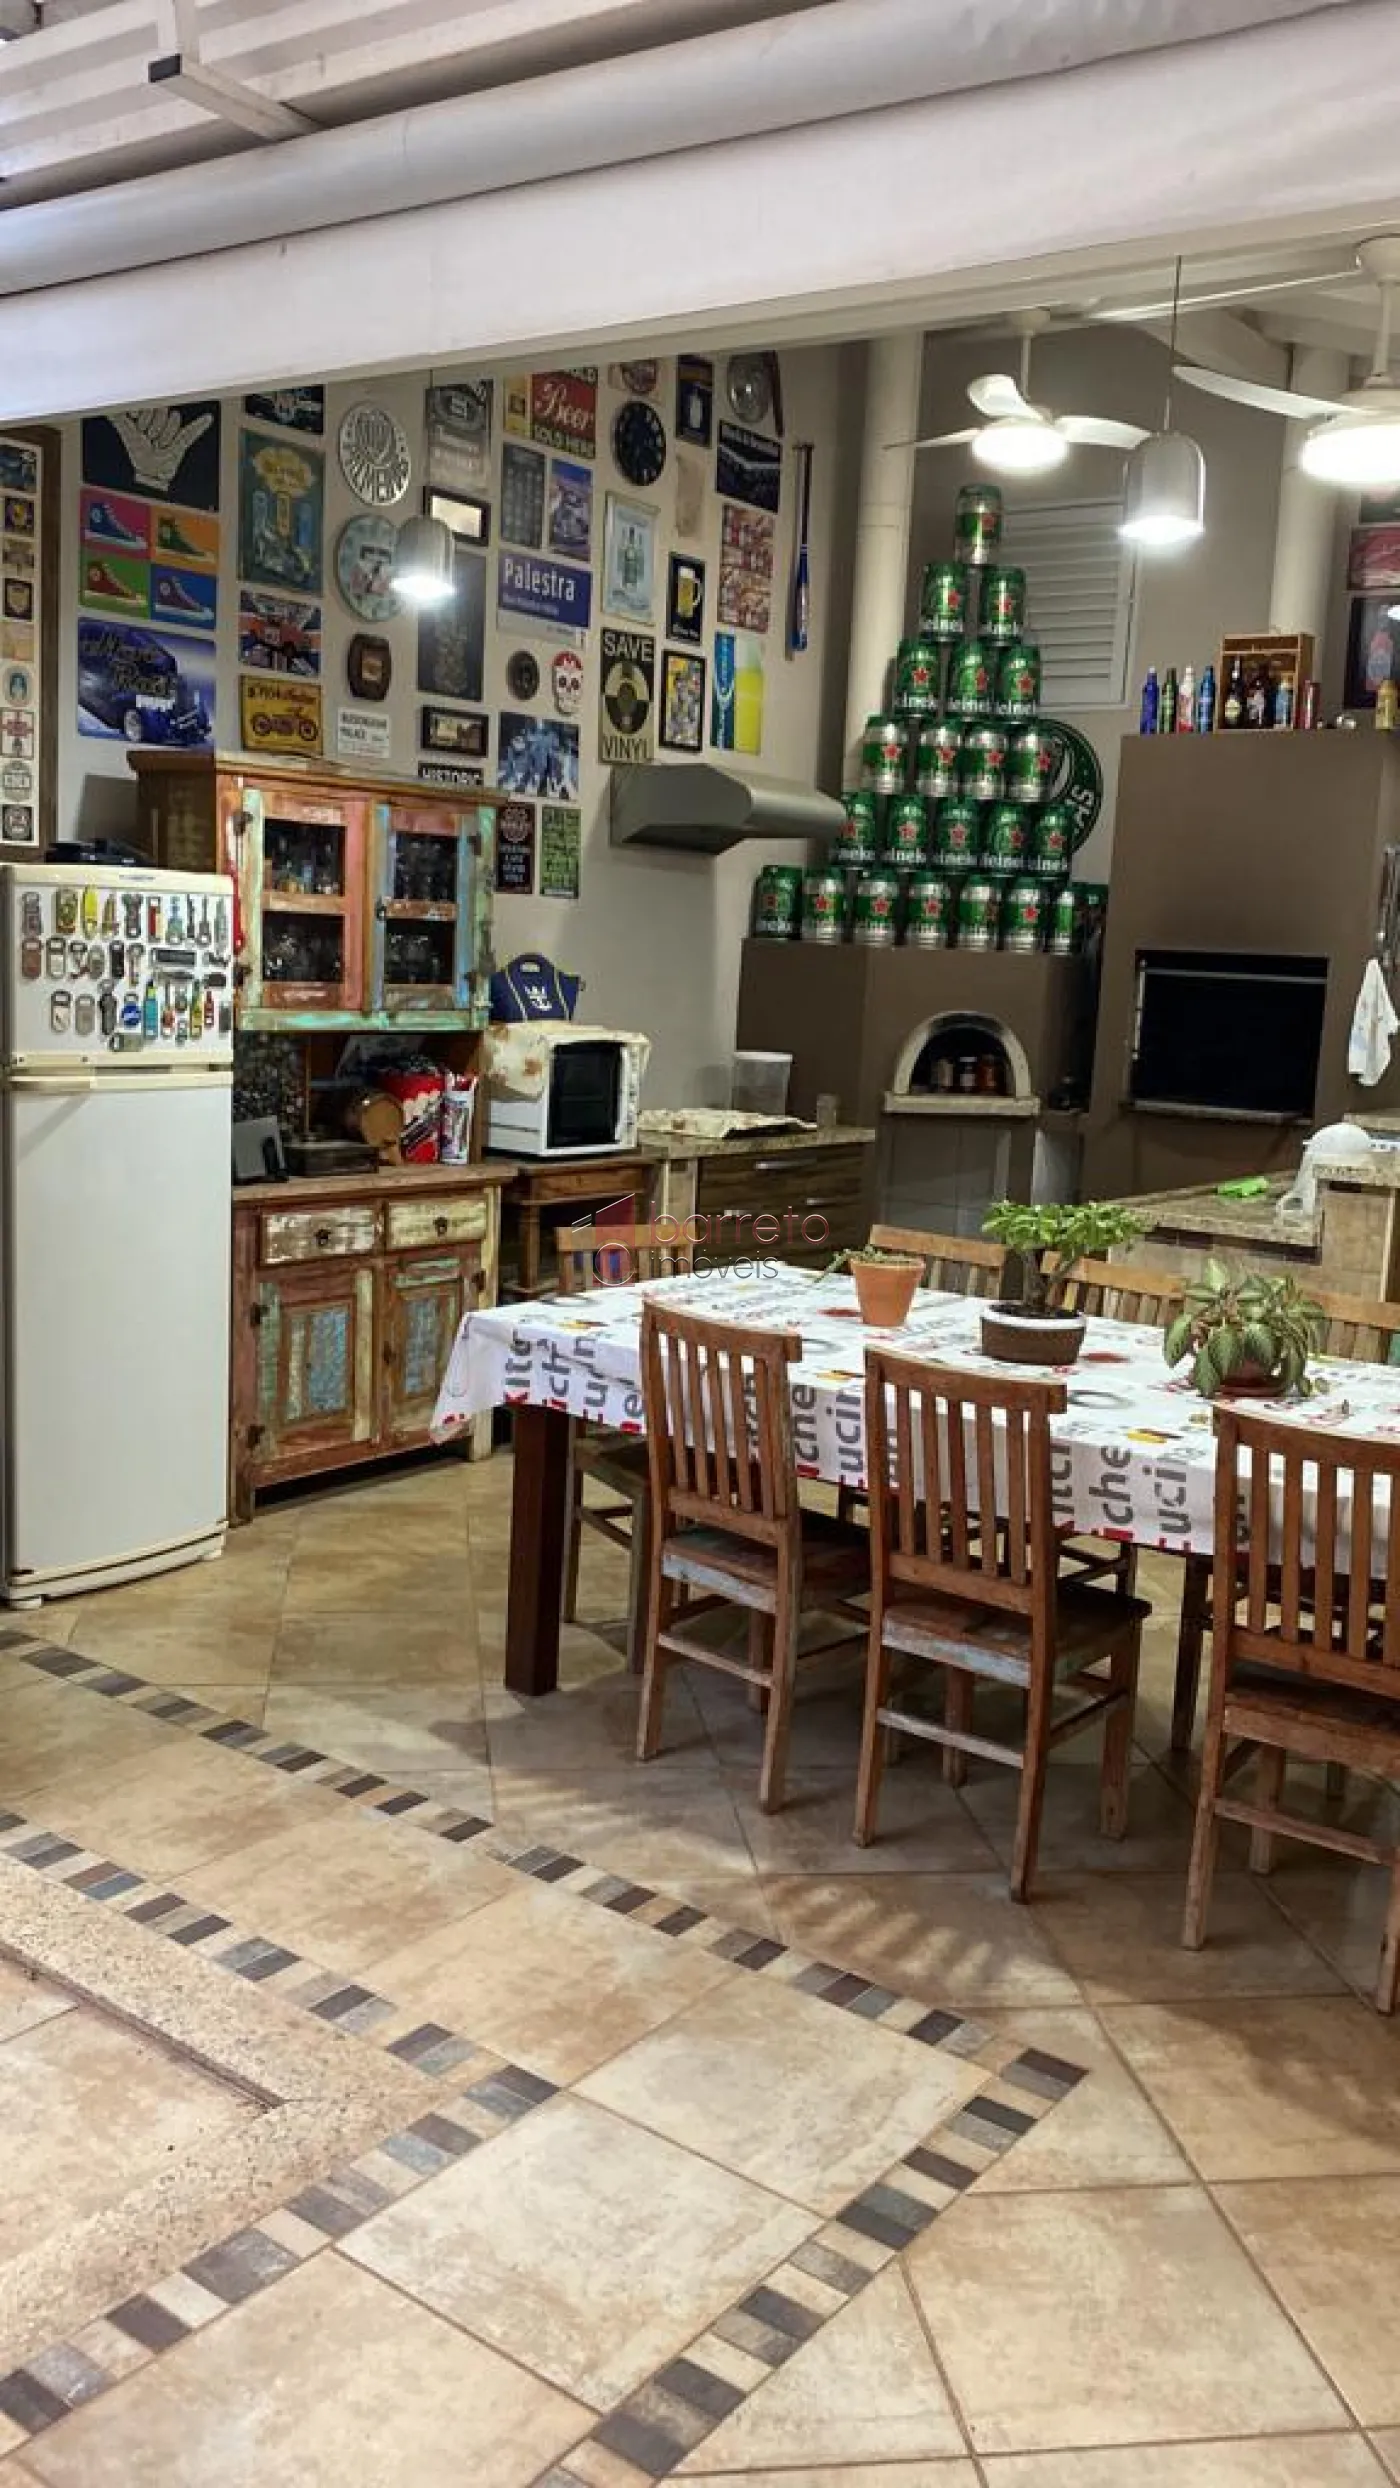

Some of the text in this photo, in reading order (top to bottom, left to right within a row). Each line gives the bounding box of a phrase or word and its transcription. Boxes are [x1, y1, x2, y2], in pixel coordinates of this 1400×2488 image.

[503, 558, 576, 602] Palestra
[604, 631, 653, 662] SAVE
[602, 734, 653, 764] VINYL
